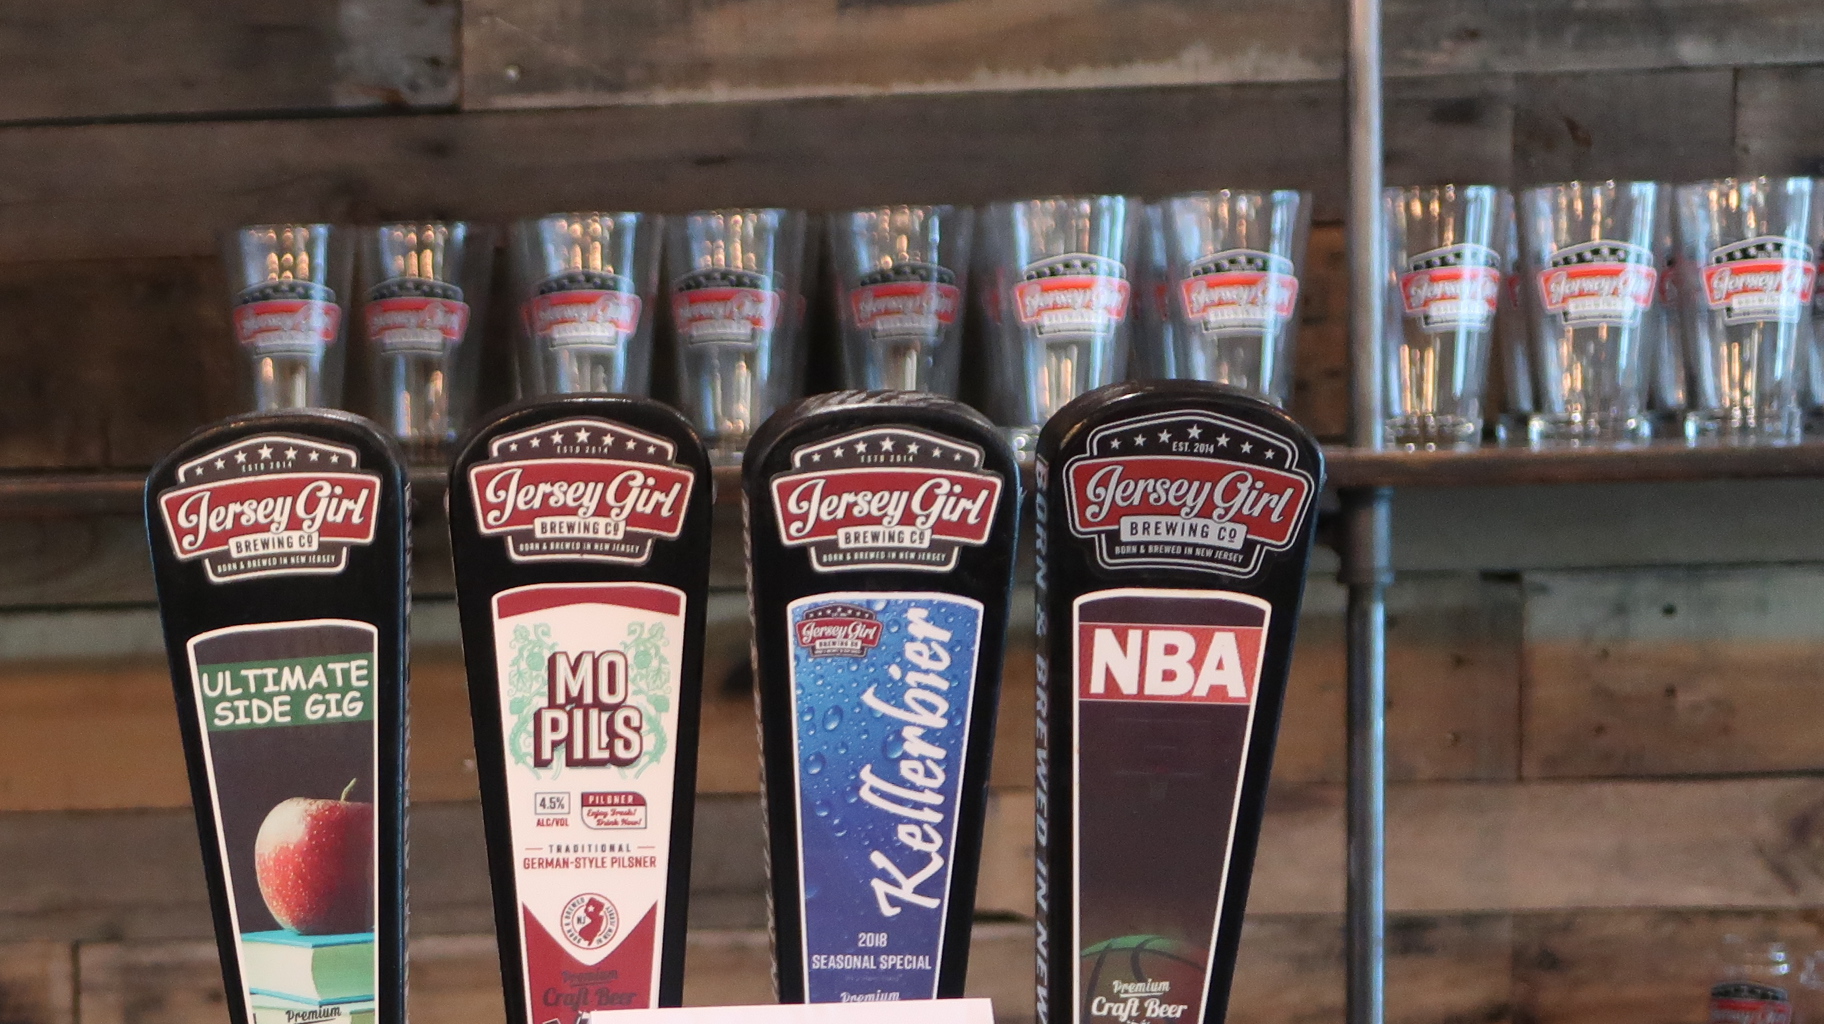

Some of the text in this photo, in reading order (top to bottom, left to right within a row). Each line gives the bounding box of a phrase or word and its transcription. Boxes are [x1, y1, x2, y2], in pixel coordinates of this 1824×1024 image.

[485, 468, 682, 526] Jersey Girl
[1085, 465, 1294, 523] Jersey Girl
[177, 481, 370, 550] Jersey Girl
[787, 477, 989, 537] Jersey Girl
[541, 521, 599, 535] BREWING
[844, 530, 904, 545] BREWING
[1130, 520, 1209, 539] BREWING
[236, 536, 294, 553] BREWING
[802, 622, 877, 644] Jersey Girl
[1089, 628, 1247, 697] NBA
[202, 660, 369, 697] ULTIMATE
[548, 650, 628, 710] MO
[213, 691, 364, 726] SIDE GIG
[534, 706, 643, 768] PILS
[859, 606, 952, 917] Kellerbier
[539, 796, 565, 810] 4.5%
[588, 795, 634, 804] PILSNER
[536, 818, 569, 827] ALC/VOL
[549, 843, 631, 853] TRADITIONAL
[523, 856, 656, 869] GERMAN-STYLE PILSNER
[858, 933, 888, 947] 2018
[812, 955, 931, 970] SEASONAL SPECIAL
[1113, 979, 1170, 993] Premium
[285, 1006, 342, 1023] Premium
[1091, 996, 1187, 1021] Craft Beer
